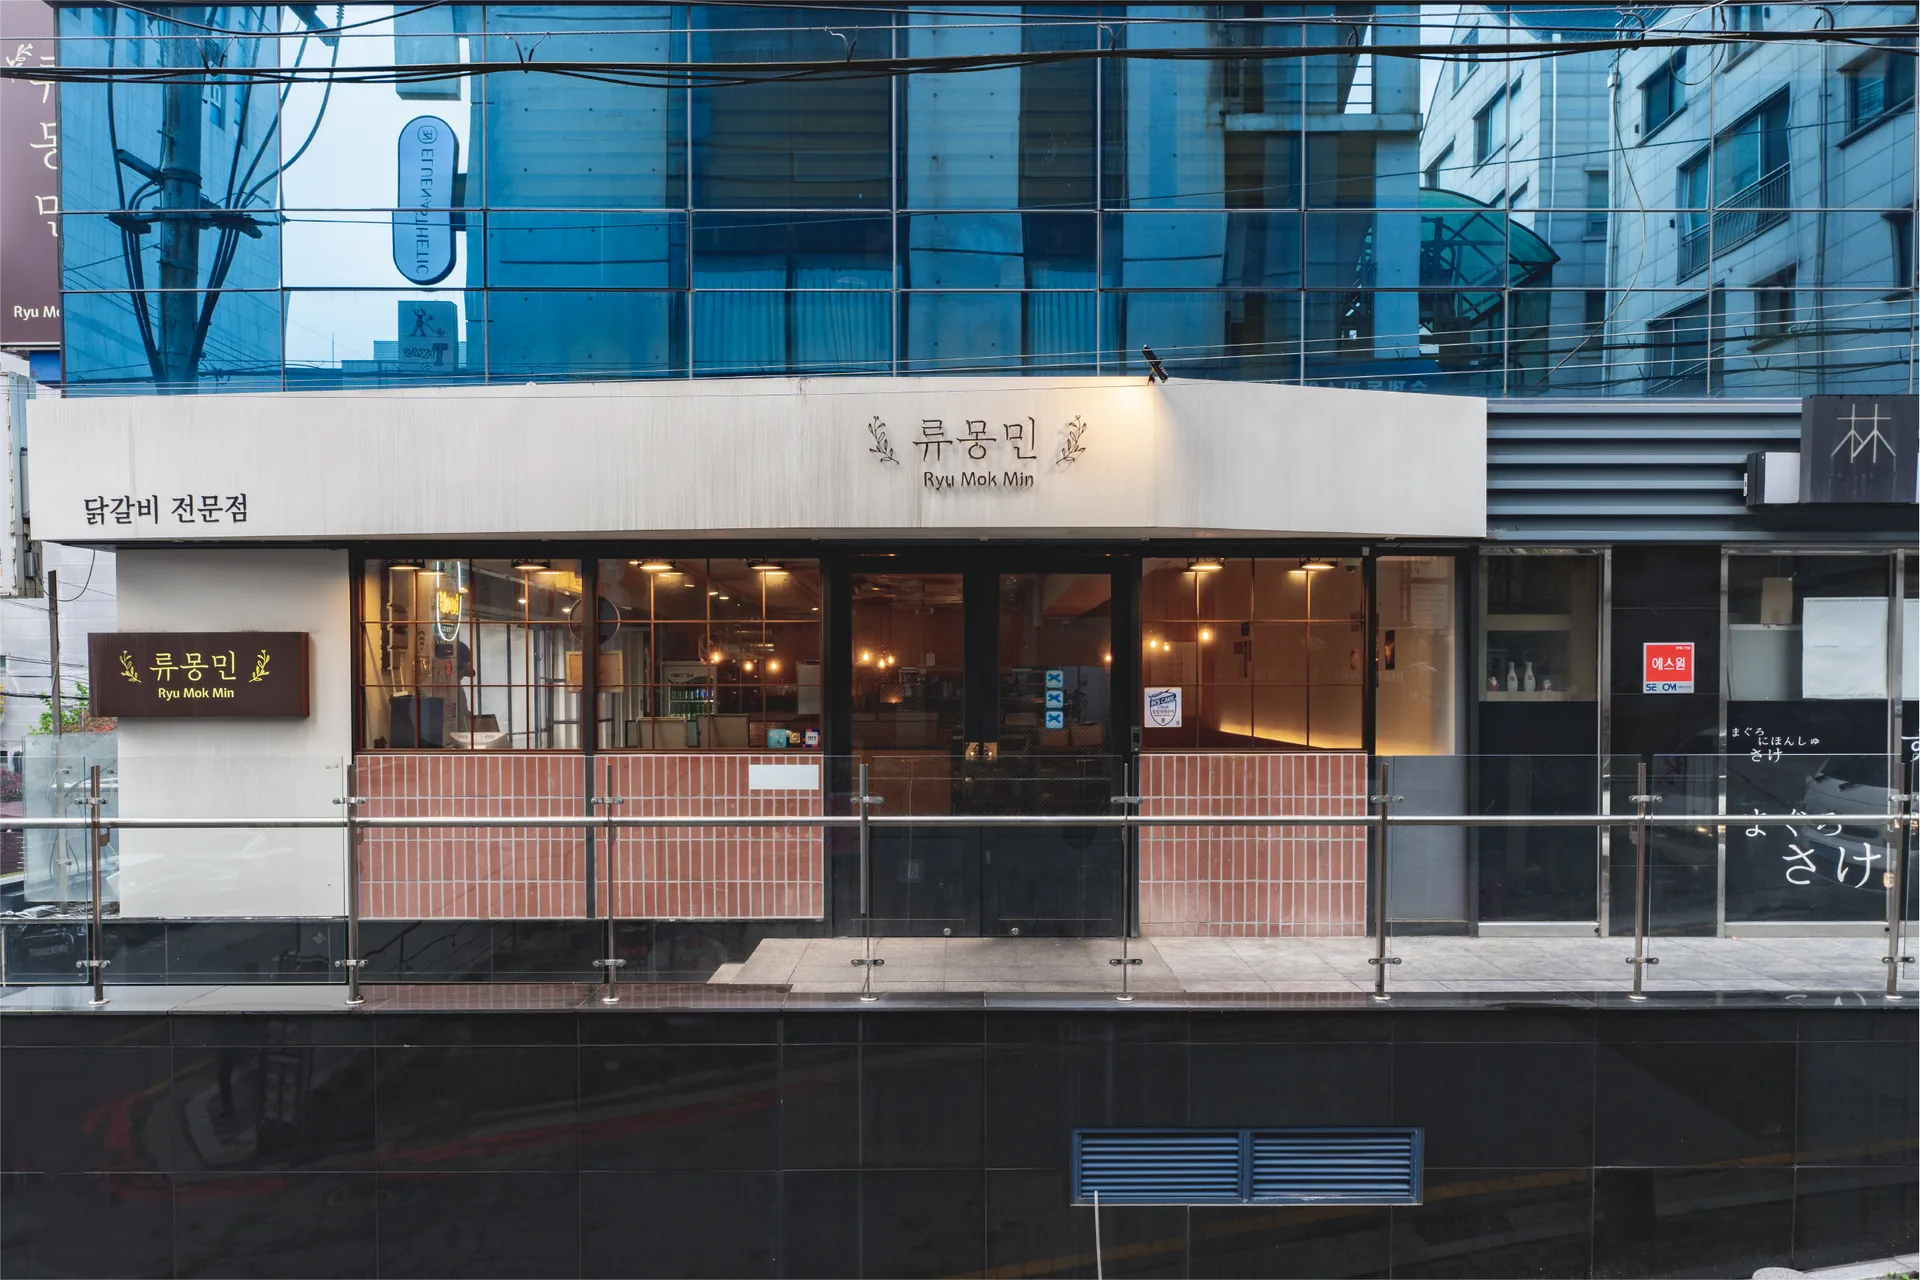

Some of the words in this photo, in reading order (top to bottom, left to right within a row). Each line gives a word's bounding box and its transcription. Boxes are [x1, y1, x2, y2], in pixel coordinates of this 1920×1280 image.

[13, 305, 39, 321] Ryu
[912, 416, 1037, 460] 류몽민
[924, 472, 955, 490] Ryu
[960, 472, 997, 487] Mok
[1003, 472, 1034, 487] Min
[84, 495, 159, 525] 닭갈비
[171, 493, 247, 523] 전문점
[149, 650, 236, 682] 류몽민
[1652, 657, 1685, 671] 에스원
[158, 687, 180, 702] Ryu
[183, 687, 210, 699] Mok
[212, 687, 234, 699] Min
[1645, 683, 1677, 692] SEOM
[1731, 727, 1765, 737] まぐろ
[1758, 736, 1820, 746] にほんしゅ
[1750, 748, 1783, 763] さけ
[1782, 842, 1882, 889] さけ
